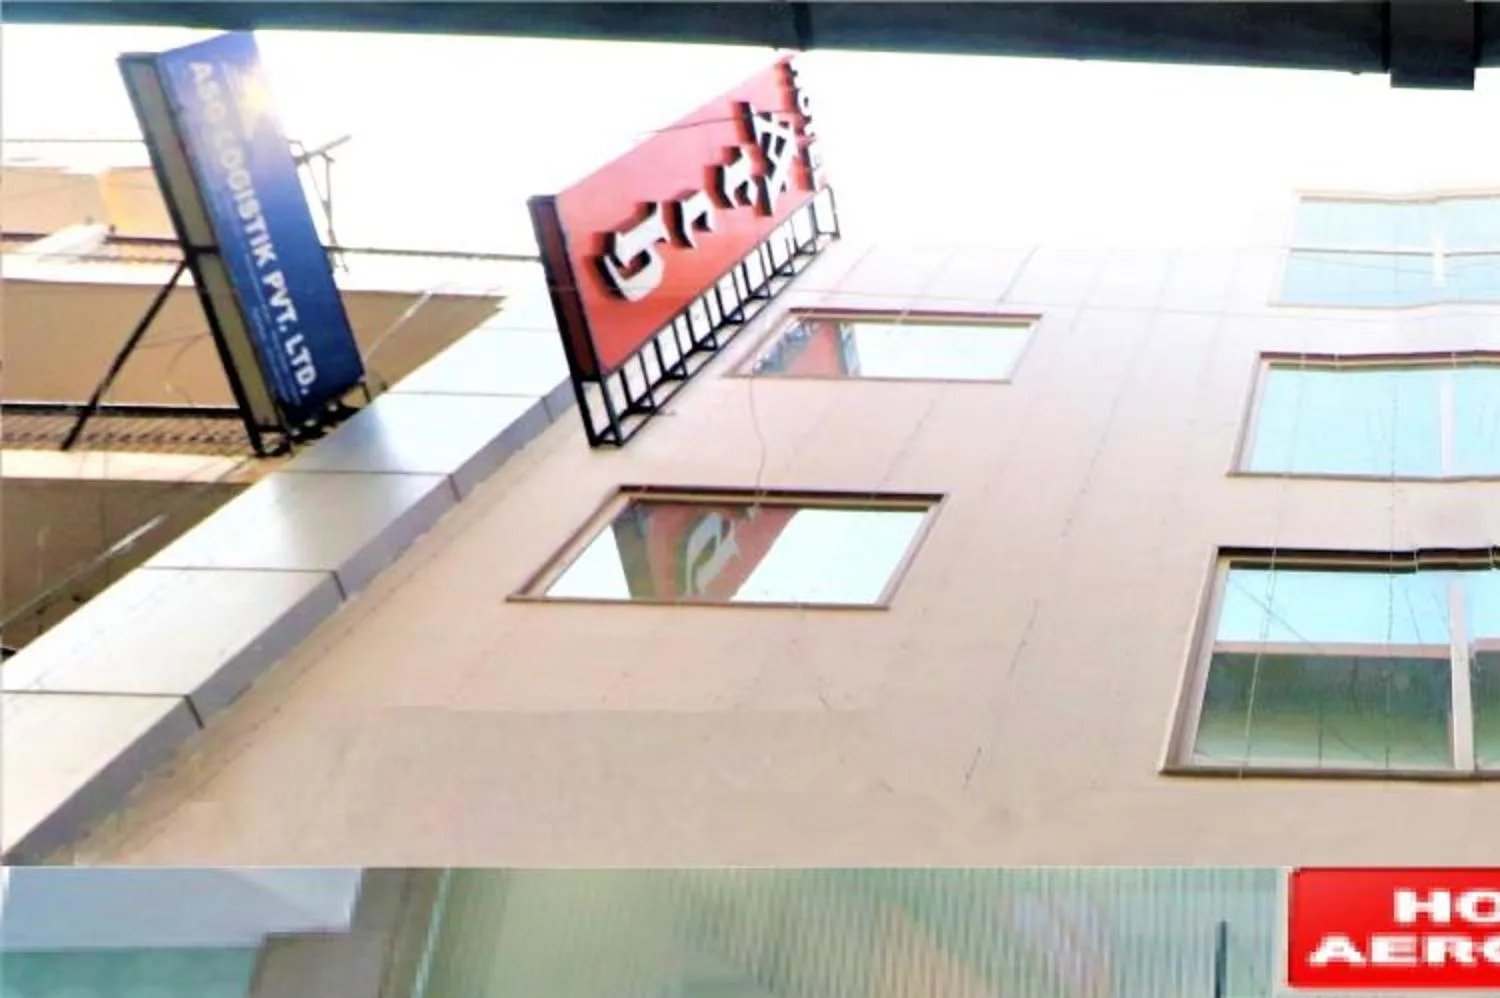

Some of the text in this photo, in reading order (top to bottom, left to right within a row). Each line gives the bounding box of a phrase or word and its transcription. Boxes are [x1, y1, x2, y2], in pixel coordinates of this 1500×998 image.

[214, 130, 277, 268] LOGISTIK
[262, 270, 297, 333] PVT.
[284, 332, 317, 395] LTD.
